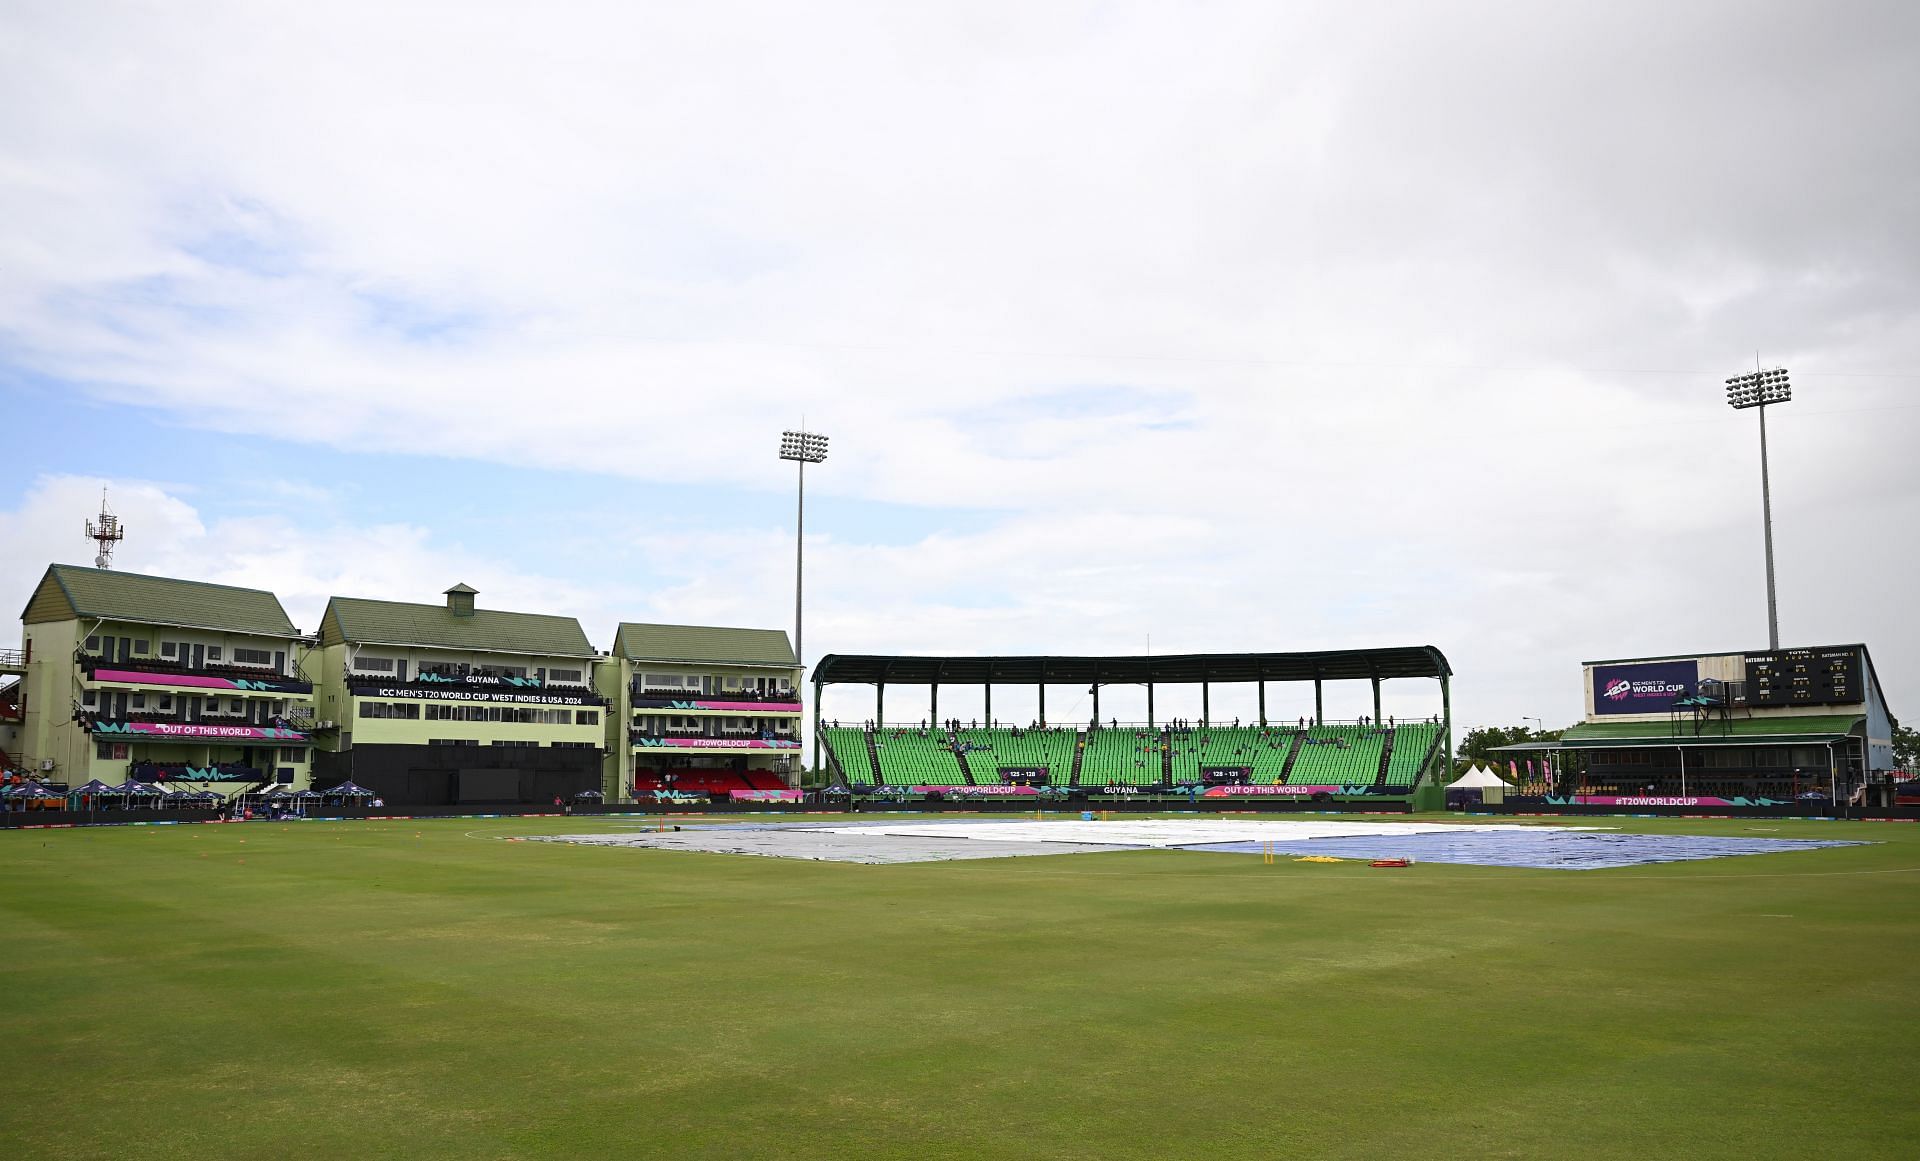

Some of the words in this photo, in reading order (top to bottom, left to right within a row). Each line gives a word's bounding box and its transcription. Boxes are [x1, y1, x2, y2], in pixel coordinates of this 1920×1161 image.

[466, 675, 499, 684] GUYANA
[1632, 685, 1664, 693] WORLD
[1666, 684, 1684, 692] CUP
[379, 688, 394, 697] ICC
[395, 689, 423, 698] MEN'S
[424, 690, 439, 699] T20
[440, 691, 471, 700] WORLD
[472, 693, 489, 701] CUP
[491, 693, 514, 702] WEST
[515, 694, 540, 703] INDIES
[548, 696, 562, 704] USA
[564, 697, 582, 705] 2024
[163, 725, 182, 733] OUT
[184, 726, 197, 734] OF
[199, 726, 218, 735] THIS
[219, 727, 251, 736] WORLD
[693, 739, 751, 747] #T20WORLDCUP
[1103, 786, 1138, 794] GUYANA
[1224, 786, 1241, 794] OUT
[1243, 786, 1255, 794] OF
[1256, 786, 1274, 794] THIS
[1276, 786, 1308, 794] WORLD
[1615, 797, 1698, 805] #T20WORLDCUP
